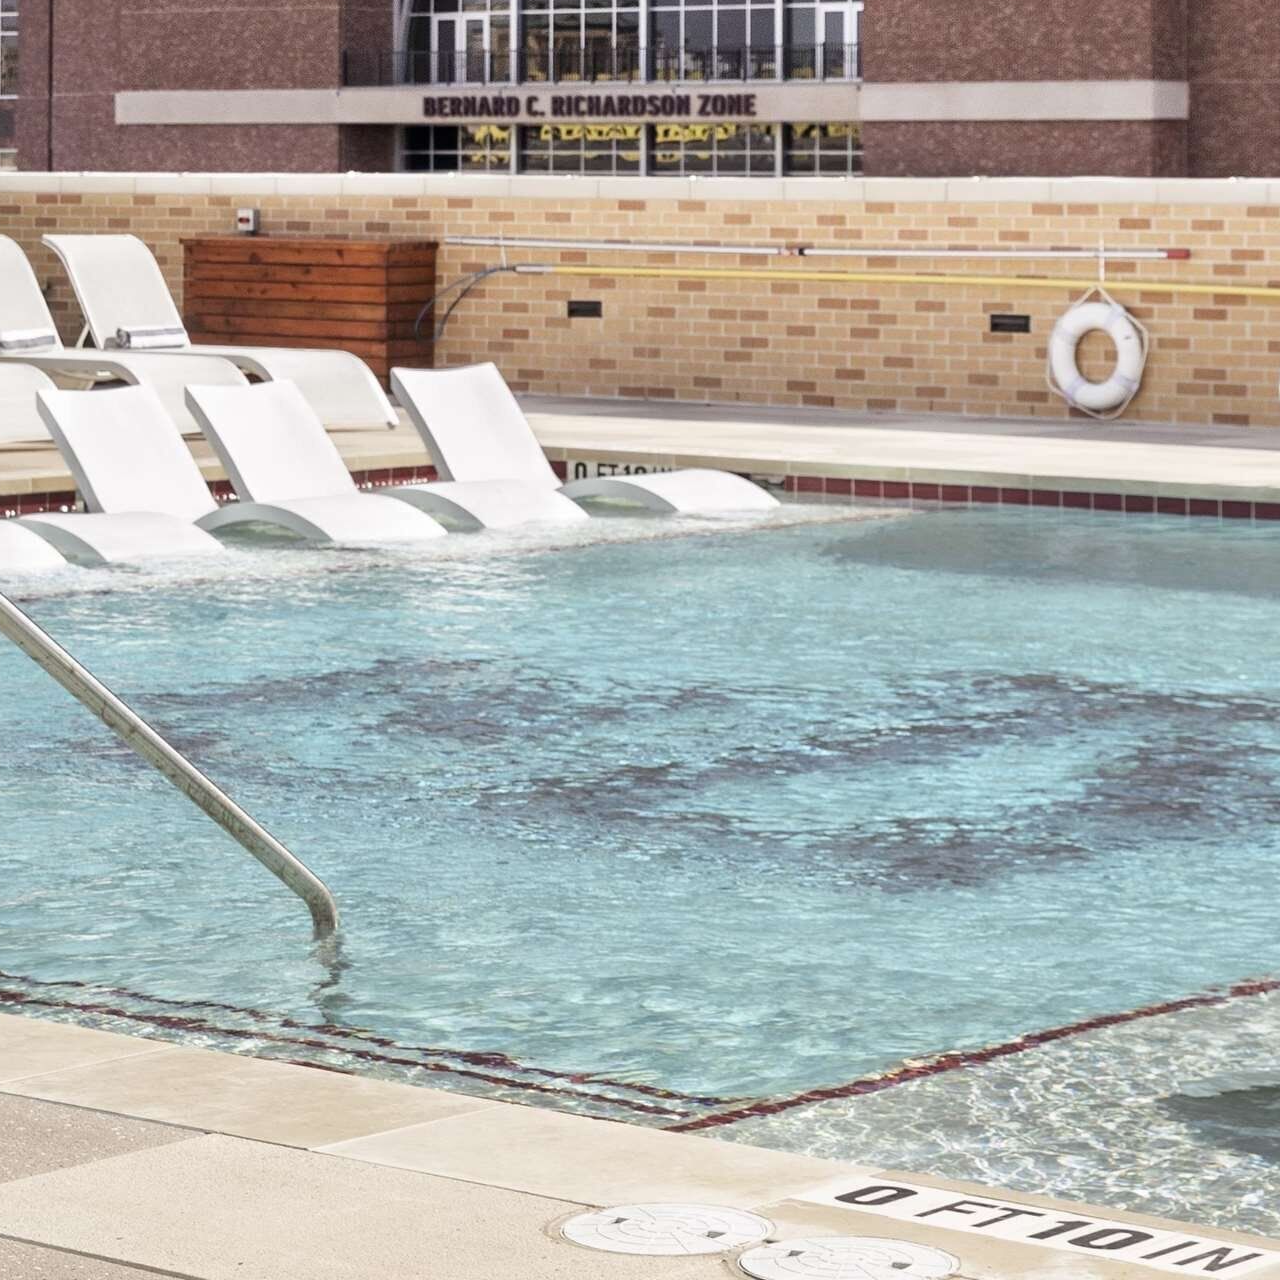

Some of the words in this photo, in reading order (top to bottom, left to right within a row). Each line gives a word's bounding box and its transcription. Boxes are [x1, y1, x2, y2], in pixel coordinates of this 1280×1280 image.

[423, 94, 520, 118] BERNARD
[526, 95, 544, 117] C.
[551, 94, 691, 117] RICHARDSON
[697, 93, 757, 116] ZONE
[834, 1185, 918, 1206] 0
[914, 1199, 1047, 1228] FT
[1028, 1219, 1155, 1250] 10
[1140, 1240, 1266, 1273] IN
